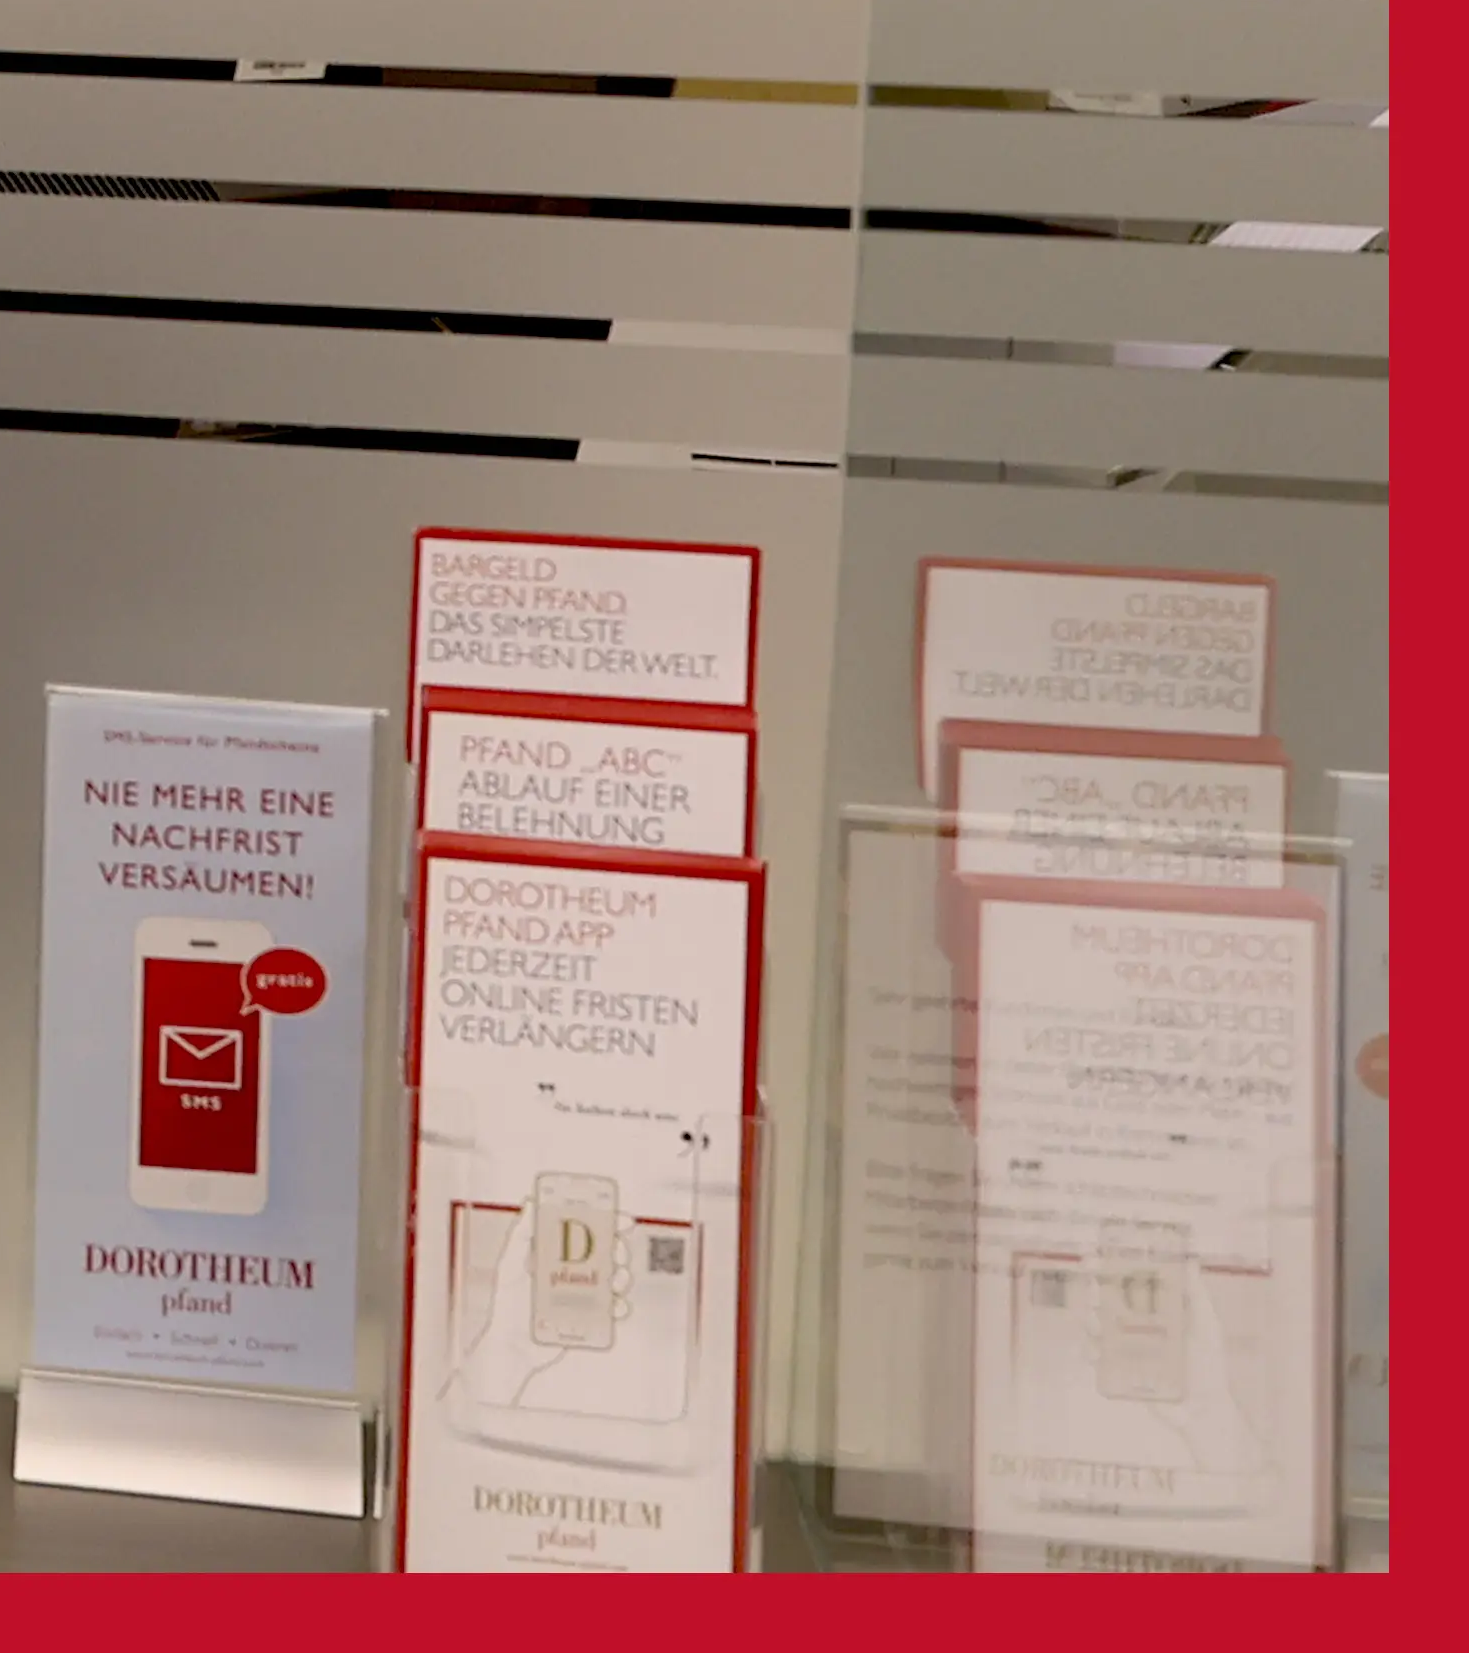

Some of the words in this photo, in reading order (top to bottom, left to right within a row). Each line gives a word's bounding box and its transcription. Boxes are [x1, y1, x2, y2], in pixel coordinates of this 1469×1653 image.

[430, 552, 558, 583] BARGELD
[429, 580, 527, 611] GEGEN
[429, 609, 484, 636] DAS
[490, 612, 625, 645] SIMPELSTE
[426, 637, 576, 671] DARLEHEN
[583, 647, 641, 674] DER
[642, 651, 719, 680] WELT.
[459, 735, 572, 770] PFAND
[83, 778, 140, 808] NIE
[151, 782, 247, 815] MEHR
[259, 788, 335, 819] EINE
[457, 768, 586, 805] ABLAUF
[595, 777, 692, 815] EINER
[111, 821, 304, 857] NACHFRIST
[456, 801, 666, 846] BELEHNUNG
[98, 860, 315, 900] VERSÄUMEN!
[443, 874, 658, 919] DOROTHEUM
[443, 909, 551, 945] PFAND
[554, 920, 615, 950] APP
[254, 970, 314, 991] gratis
[439, 944, 599, 982] JEDERZEIT
[439, 978, 564, 1017] ONLINE
[572, 988, 700, 1028] FRISTEN
[439, 1011, 656, 1059] VERLÄNGERN
[179, 1092, 223, 1112] SMS
[84, 1241, 317, 1291] DOROTHEUM
[160, 1290, 233, 1317] pfand
[472, 1484, 665, 1529] DOROTHEUM
[536, 1525, 598, 1551] pfand
